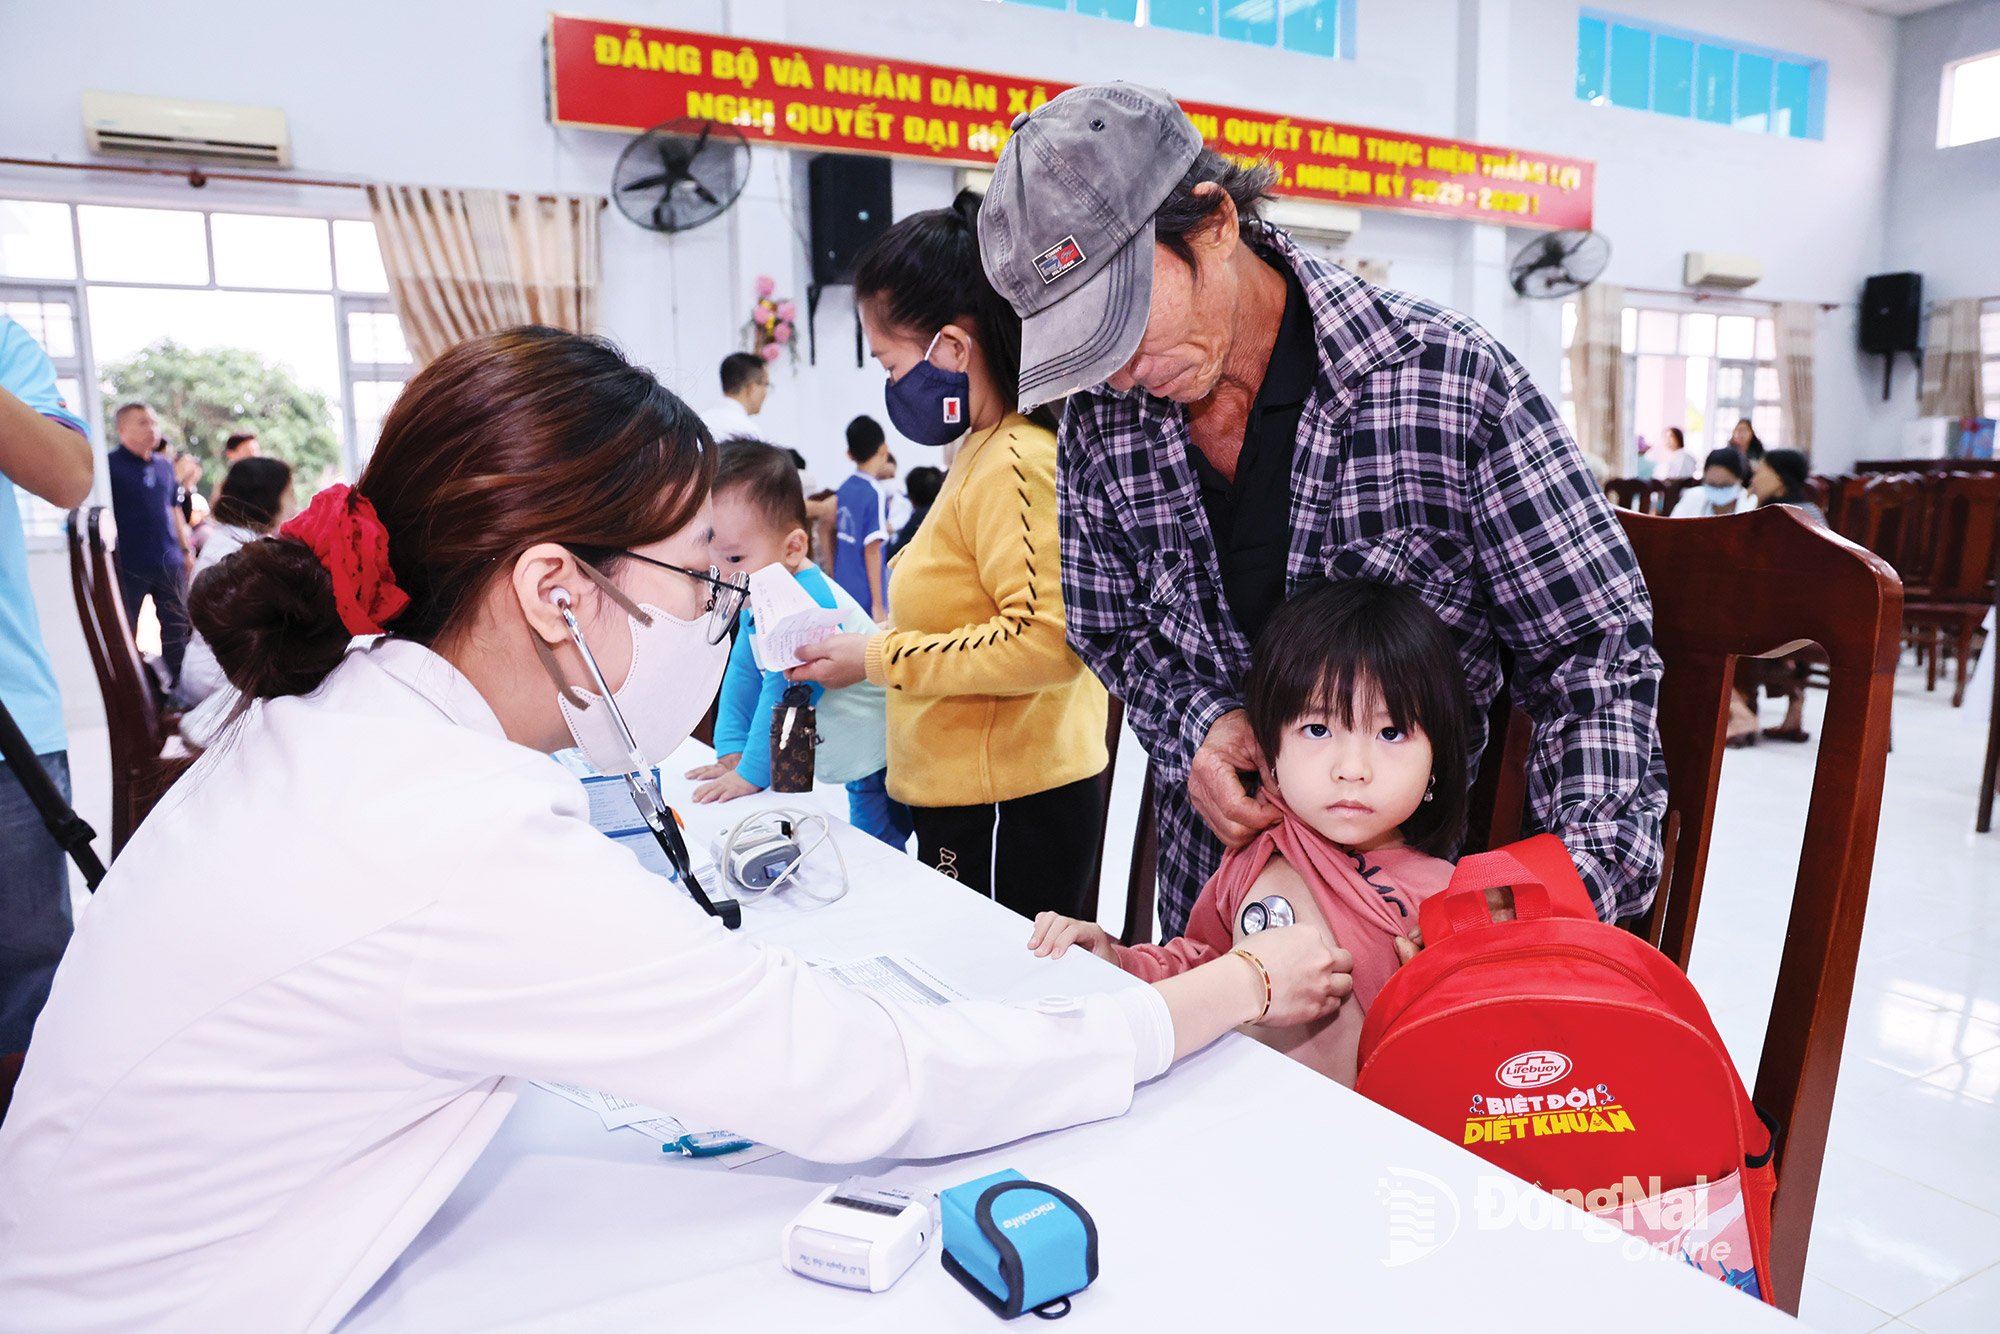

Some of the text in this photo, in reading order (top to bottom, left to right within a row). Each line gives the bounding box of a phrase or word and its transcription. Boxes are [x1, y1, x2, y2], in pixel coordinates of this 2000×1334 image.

[594, 28, 702, 76] ĐẢNG
[711, 46, 760, 90] BỘ
[769, 52, 814, 90] VÀ
[824, 63, 922, 103] NHÂN
[930, 74, 998, 113] DÂN
[1224, 117, 1303, 151] QUYẾT
[1308, 126, 1360, 160] TÂM
[1364, 137, 1423, 171] THỰC
[1427, 145, 1477, 176] HIỆN
[686, 90, 776, 136] NGHỊ
[785, 102, 895, 141] QUYẾT
[903, 115, 960, 152] ĐẠI
[967, 119, 1014, 159] HỘ
[1296, 162, 1371, 198] NHIỆM
[1505, 1063, 1562, 1076] Lifebuoy
[1485, 1086, 1598, 1117] BIỆT ĐỘI
[1463, 1106, 1637, 1145] DIỆT KHUẨN
[1002, 1201, 1056, 1229] microlife
